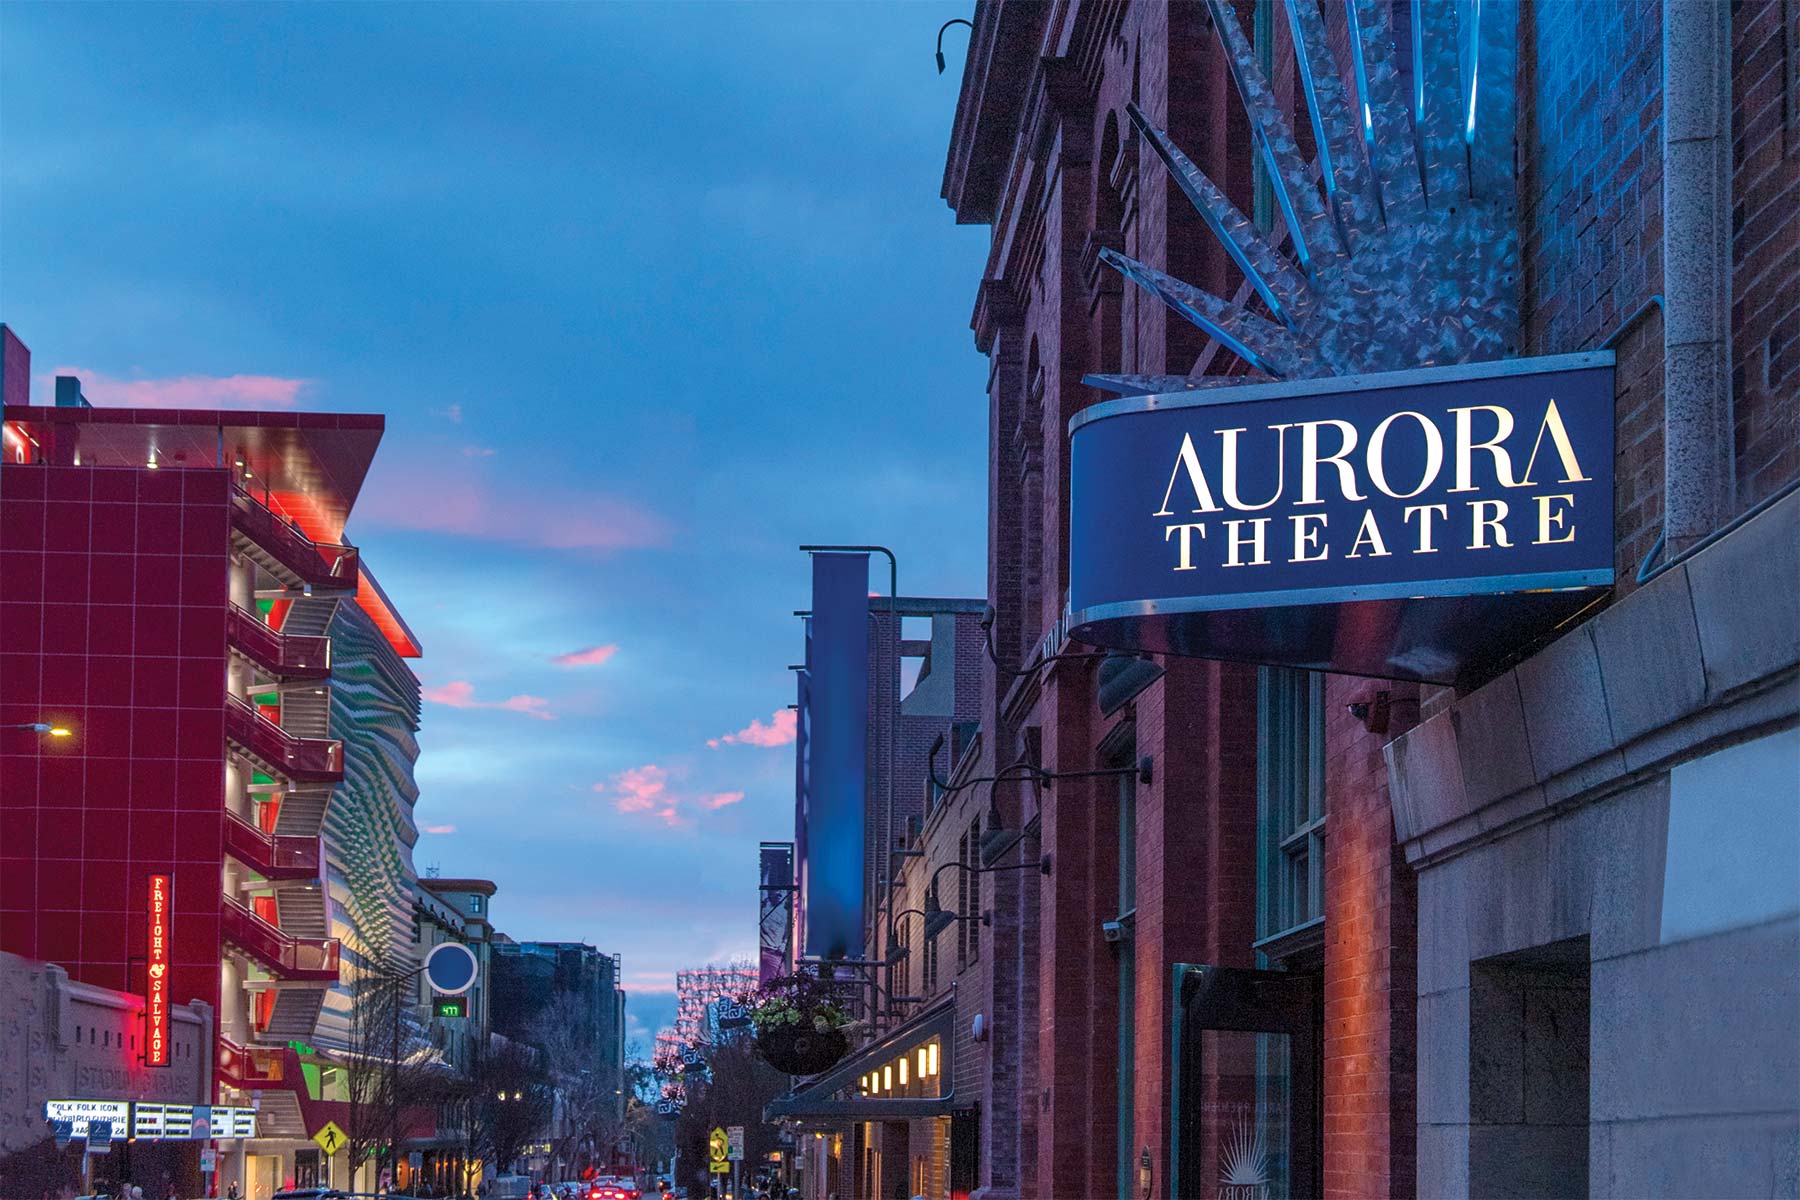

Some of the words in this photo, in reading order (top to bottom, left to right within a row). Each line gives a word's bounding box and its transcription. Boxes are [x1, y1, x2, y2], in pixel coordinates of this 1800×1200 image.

[1152, 398, 1592, 516] AURORA
[1165, 493, 1576, 571] THEATRE
[153, 878, 163, 959] FREIGHT
[153, 980, 162, 1062] SALVAGE
